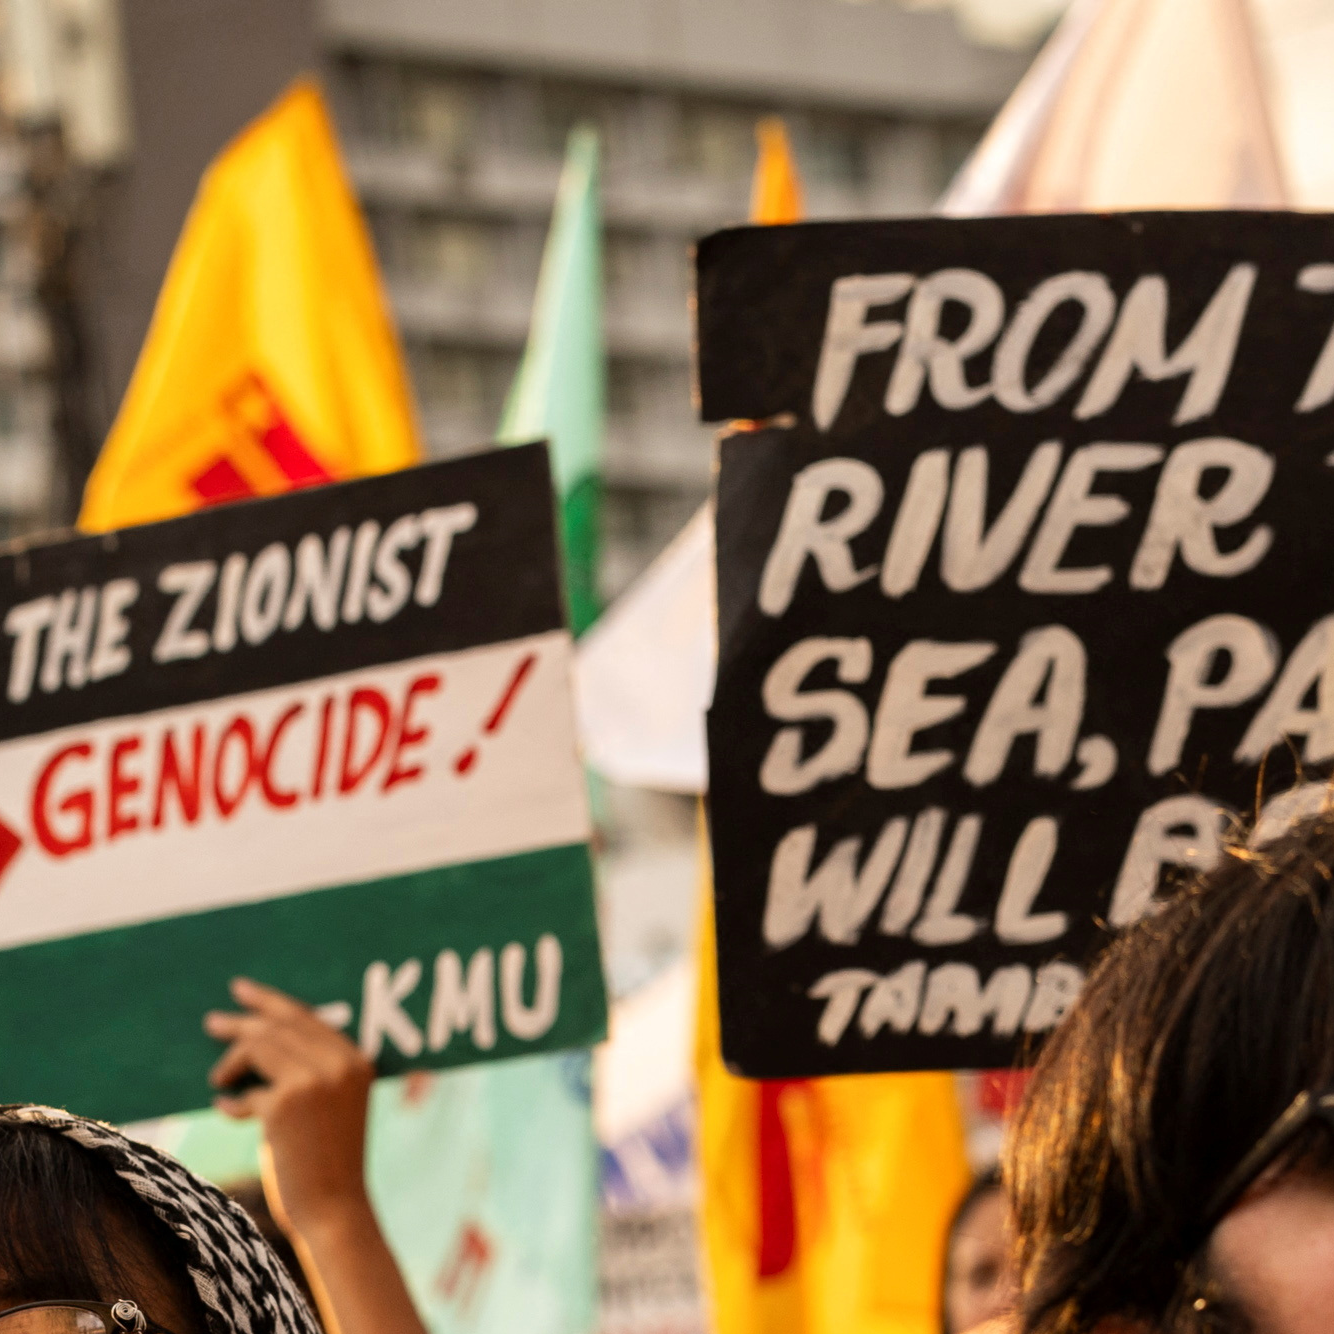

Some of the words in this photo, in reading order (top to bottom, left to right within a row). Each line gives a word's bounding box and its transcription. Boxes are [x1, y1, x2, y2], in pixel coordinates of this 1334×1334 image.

[813, 262, 1257, 428] FROM
[4, 577, 141, 704] THE
[152, 502, 479, 664] ZIONIST
[757, 436, 1275, 614] RIVER
[757, 624, 1119, 796] SEA,
[761, 808, 1069, 950] WILL
